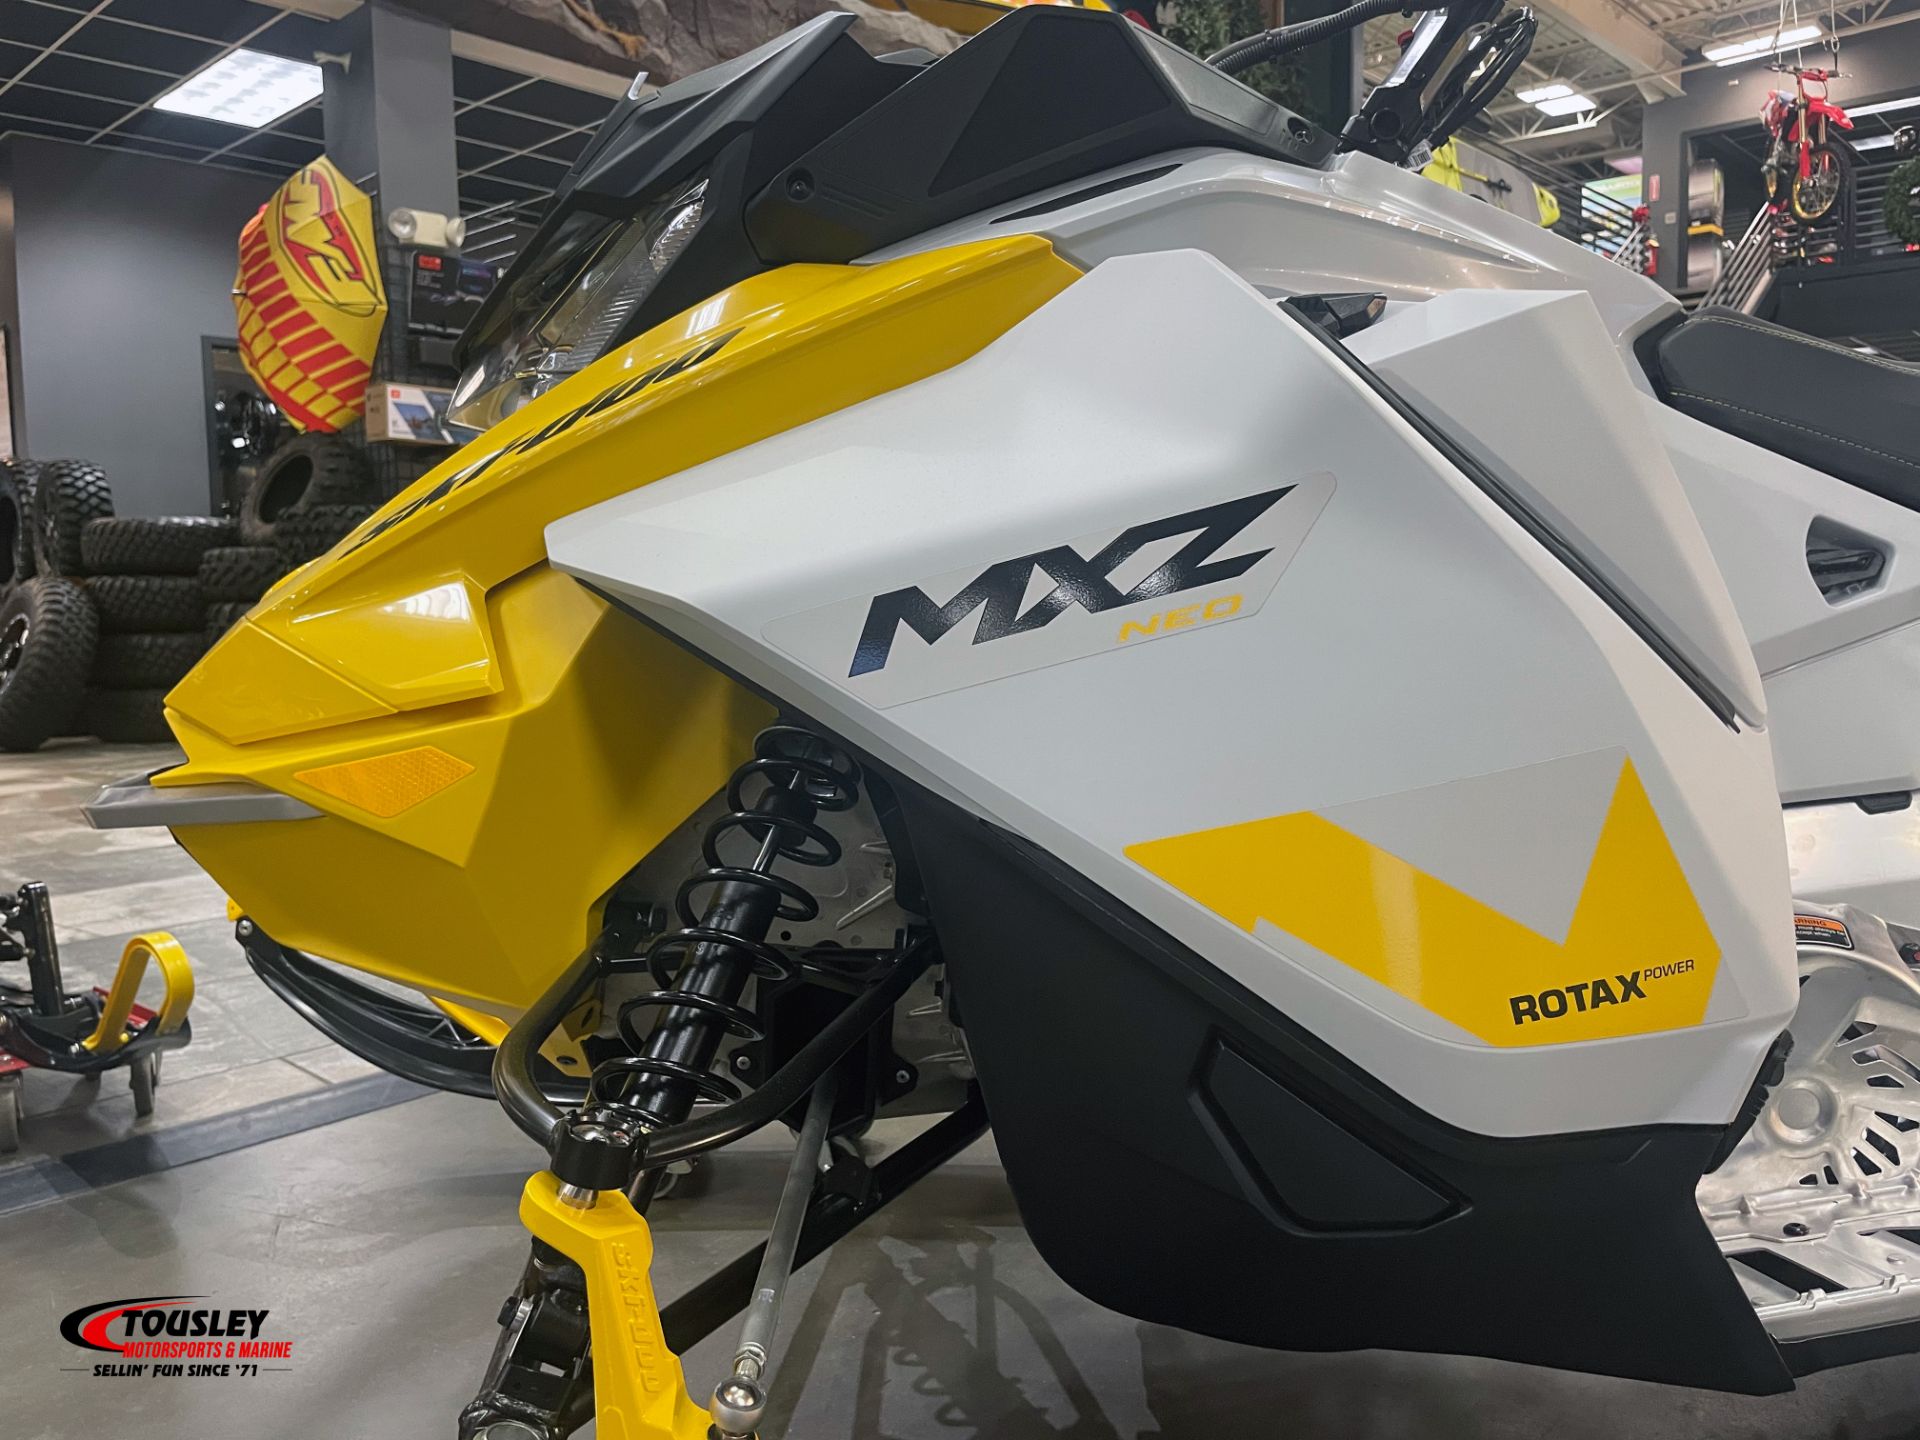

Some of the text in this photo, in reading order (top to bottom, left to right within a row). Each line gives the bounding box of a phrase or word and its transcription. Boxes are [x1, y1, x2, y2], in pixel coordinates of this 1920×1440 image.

[848, 483, 1299, 678] MXZ
[1117, 594, 1244, 643] NEO
[1795, 917, 1827, 927] ARNING
[1509, 959, 1695, 1025] ROTAX POWER
